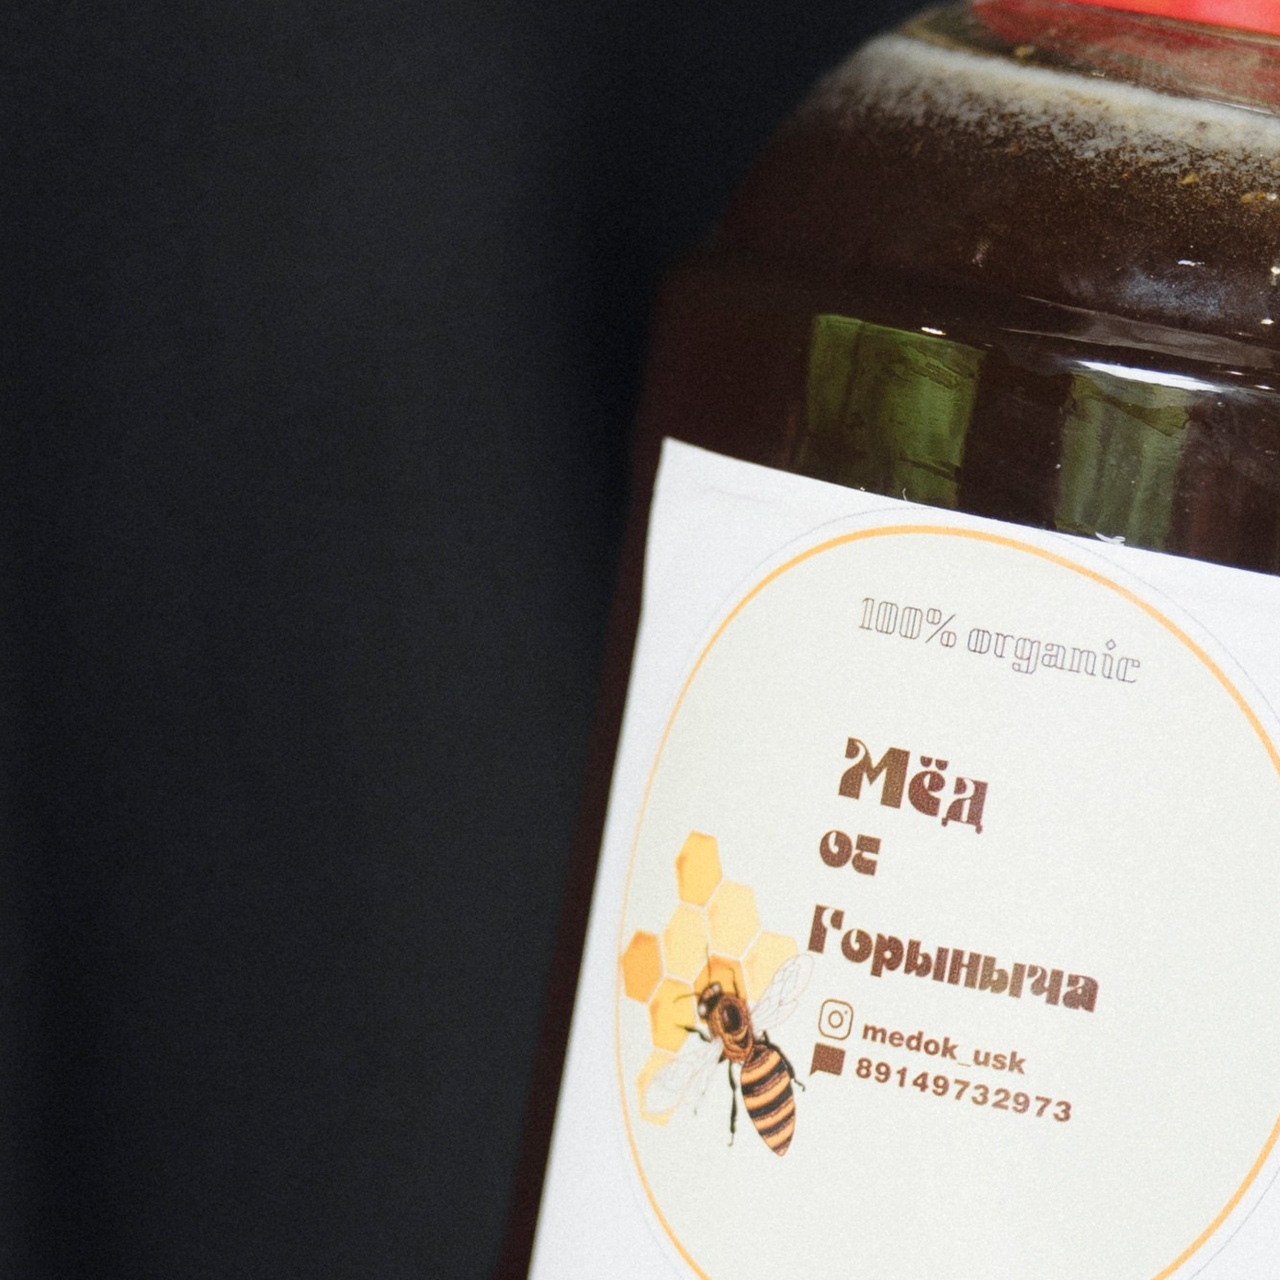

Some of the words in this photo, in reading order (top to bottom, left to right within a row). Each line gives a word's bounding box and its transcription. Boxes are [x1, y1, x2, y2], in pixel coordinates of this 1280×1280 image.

[858, 596, 958, 649] 100%
[966, 626, 1142, 685] organic
[837, 736, 989, 835] Мёд
[818, 830, 882, 877] от
[806, 904, 1099, 1013] Горыныча
[861, 1023, 1027, 1075] medok_usk
[855, 1057, 1072, 1123] 89149732973
